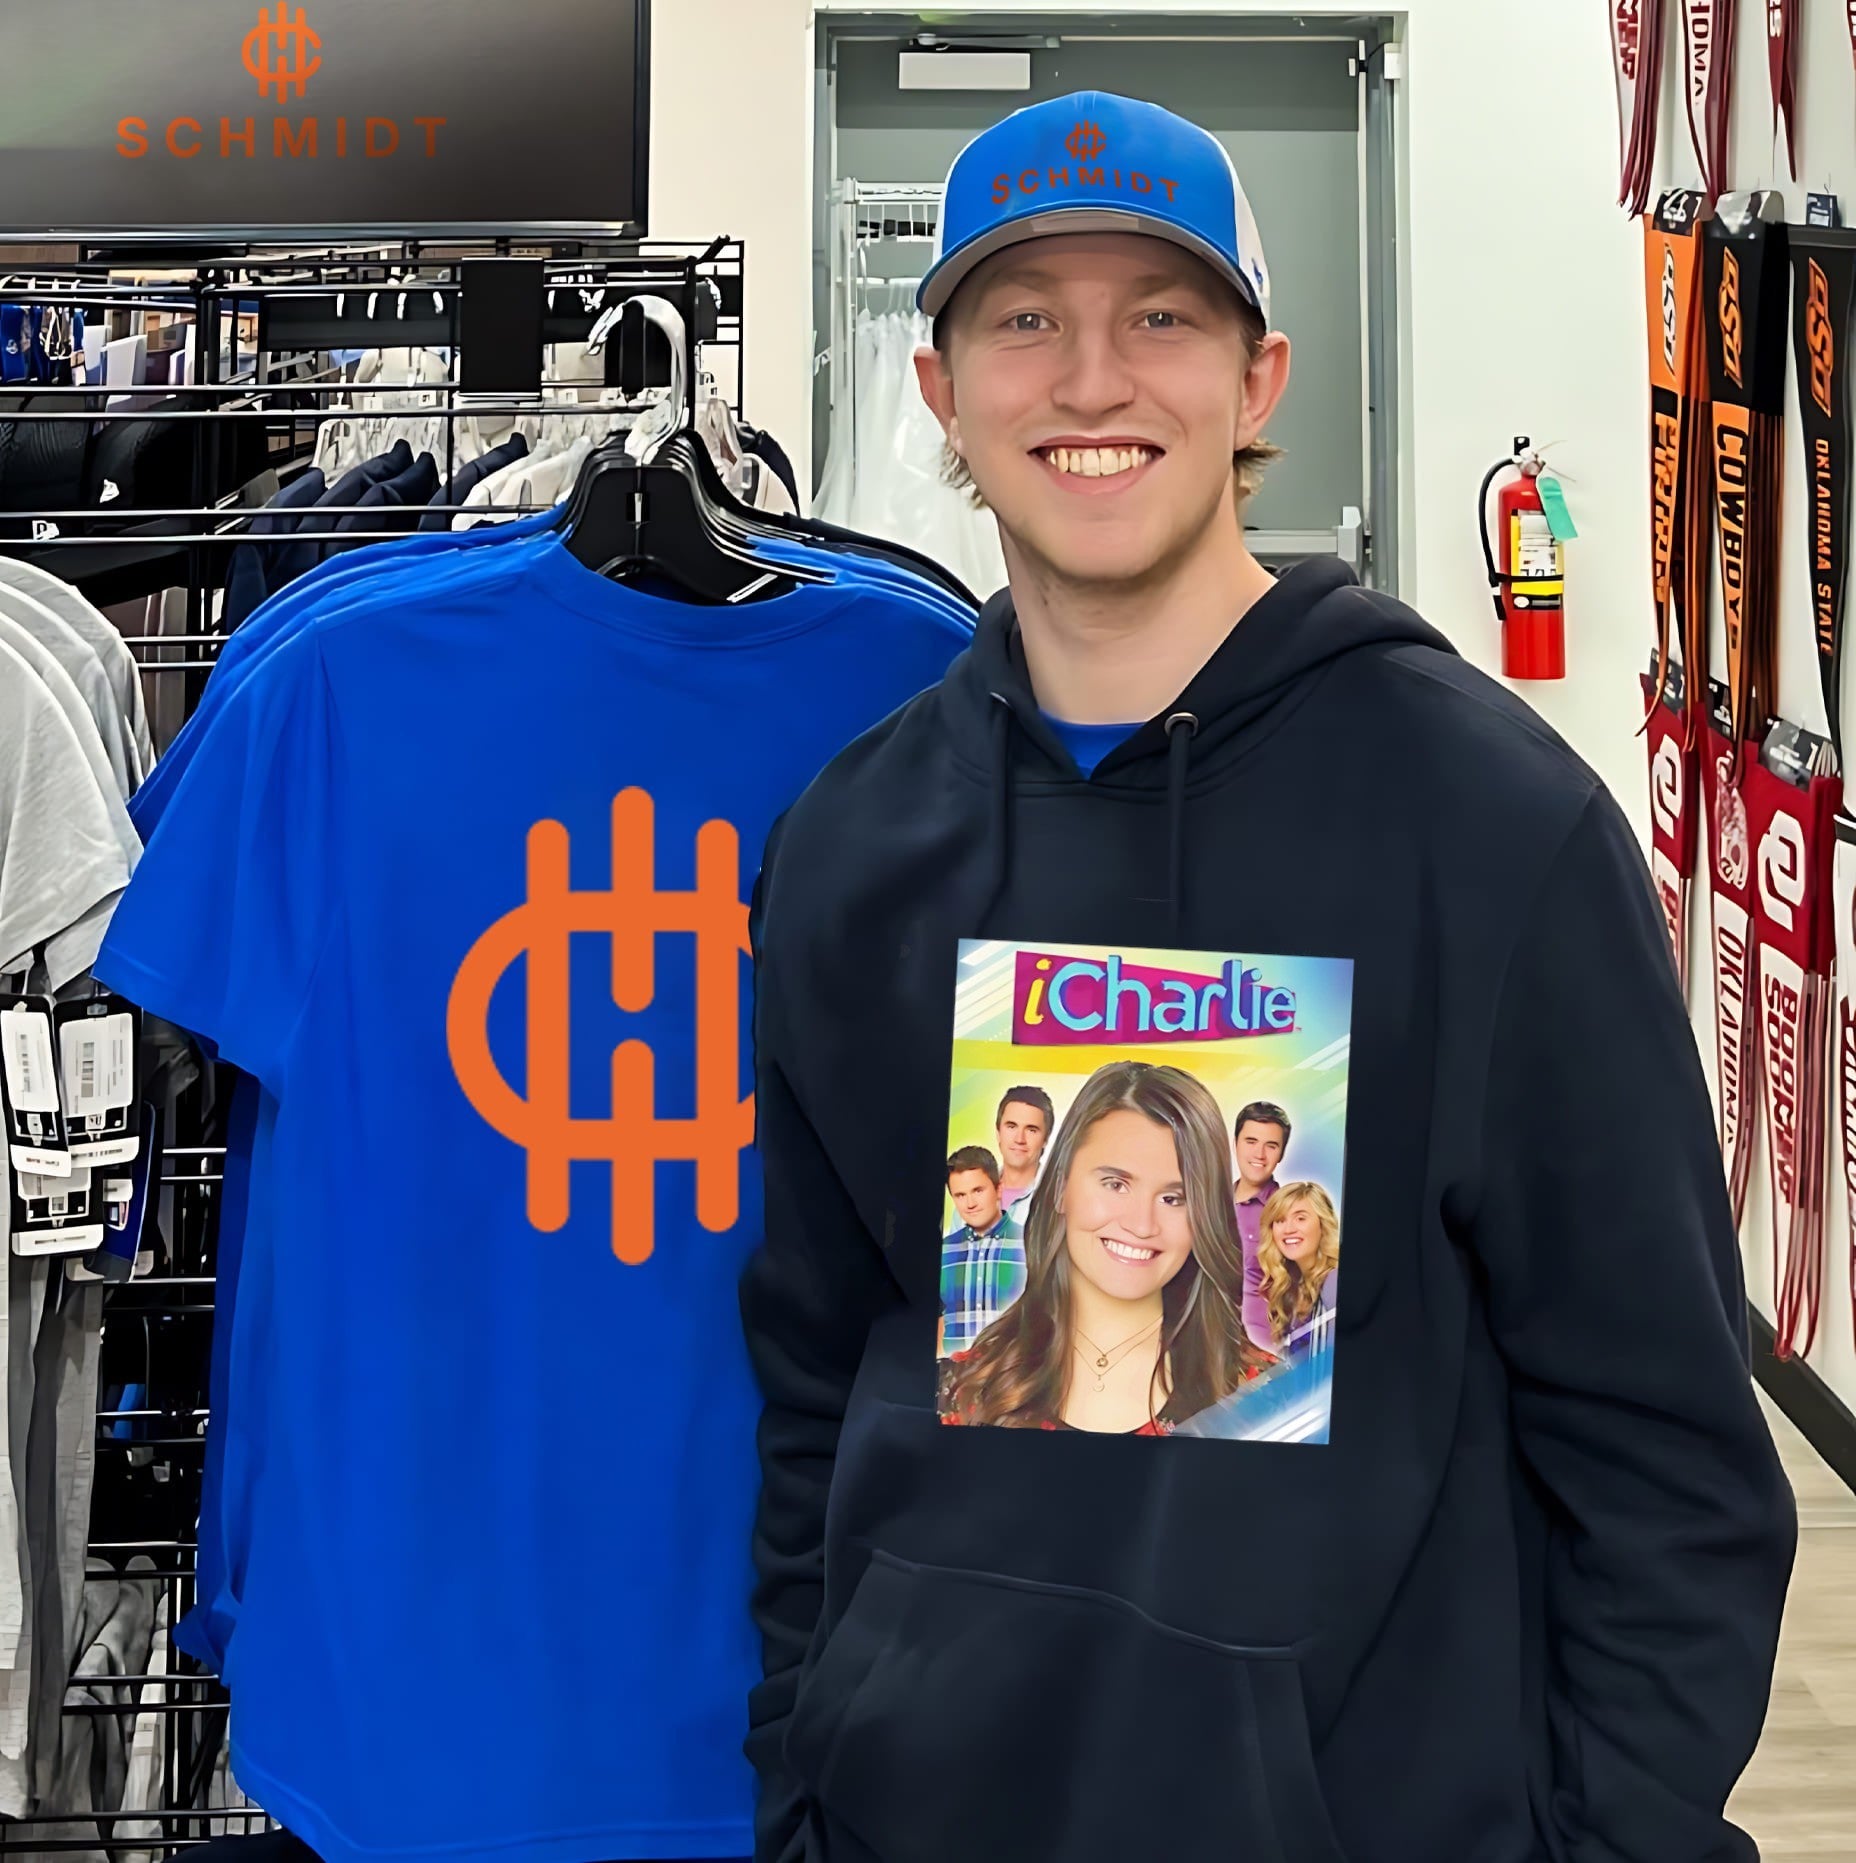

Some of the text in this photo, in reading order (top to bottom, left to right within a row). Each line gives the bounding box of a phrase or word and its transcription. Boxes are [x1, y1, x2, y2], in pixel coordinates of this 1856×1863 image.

[116, 116, 447, 159] SCHMIDT
[992, 167, 1179, 204] SCHMIDT
[1815, 438, 1832, 570] OKLAHOMA
[1024, 954, 1297, 1032] iCharlie
[1718, 926, 1746, 1143] OKLAHOMA
